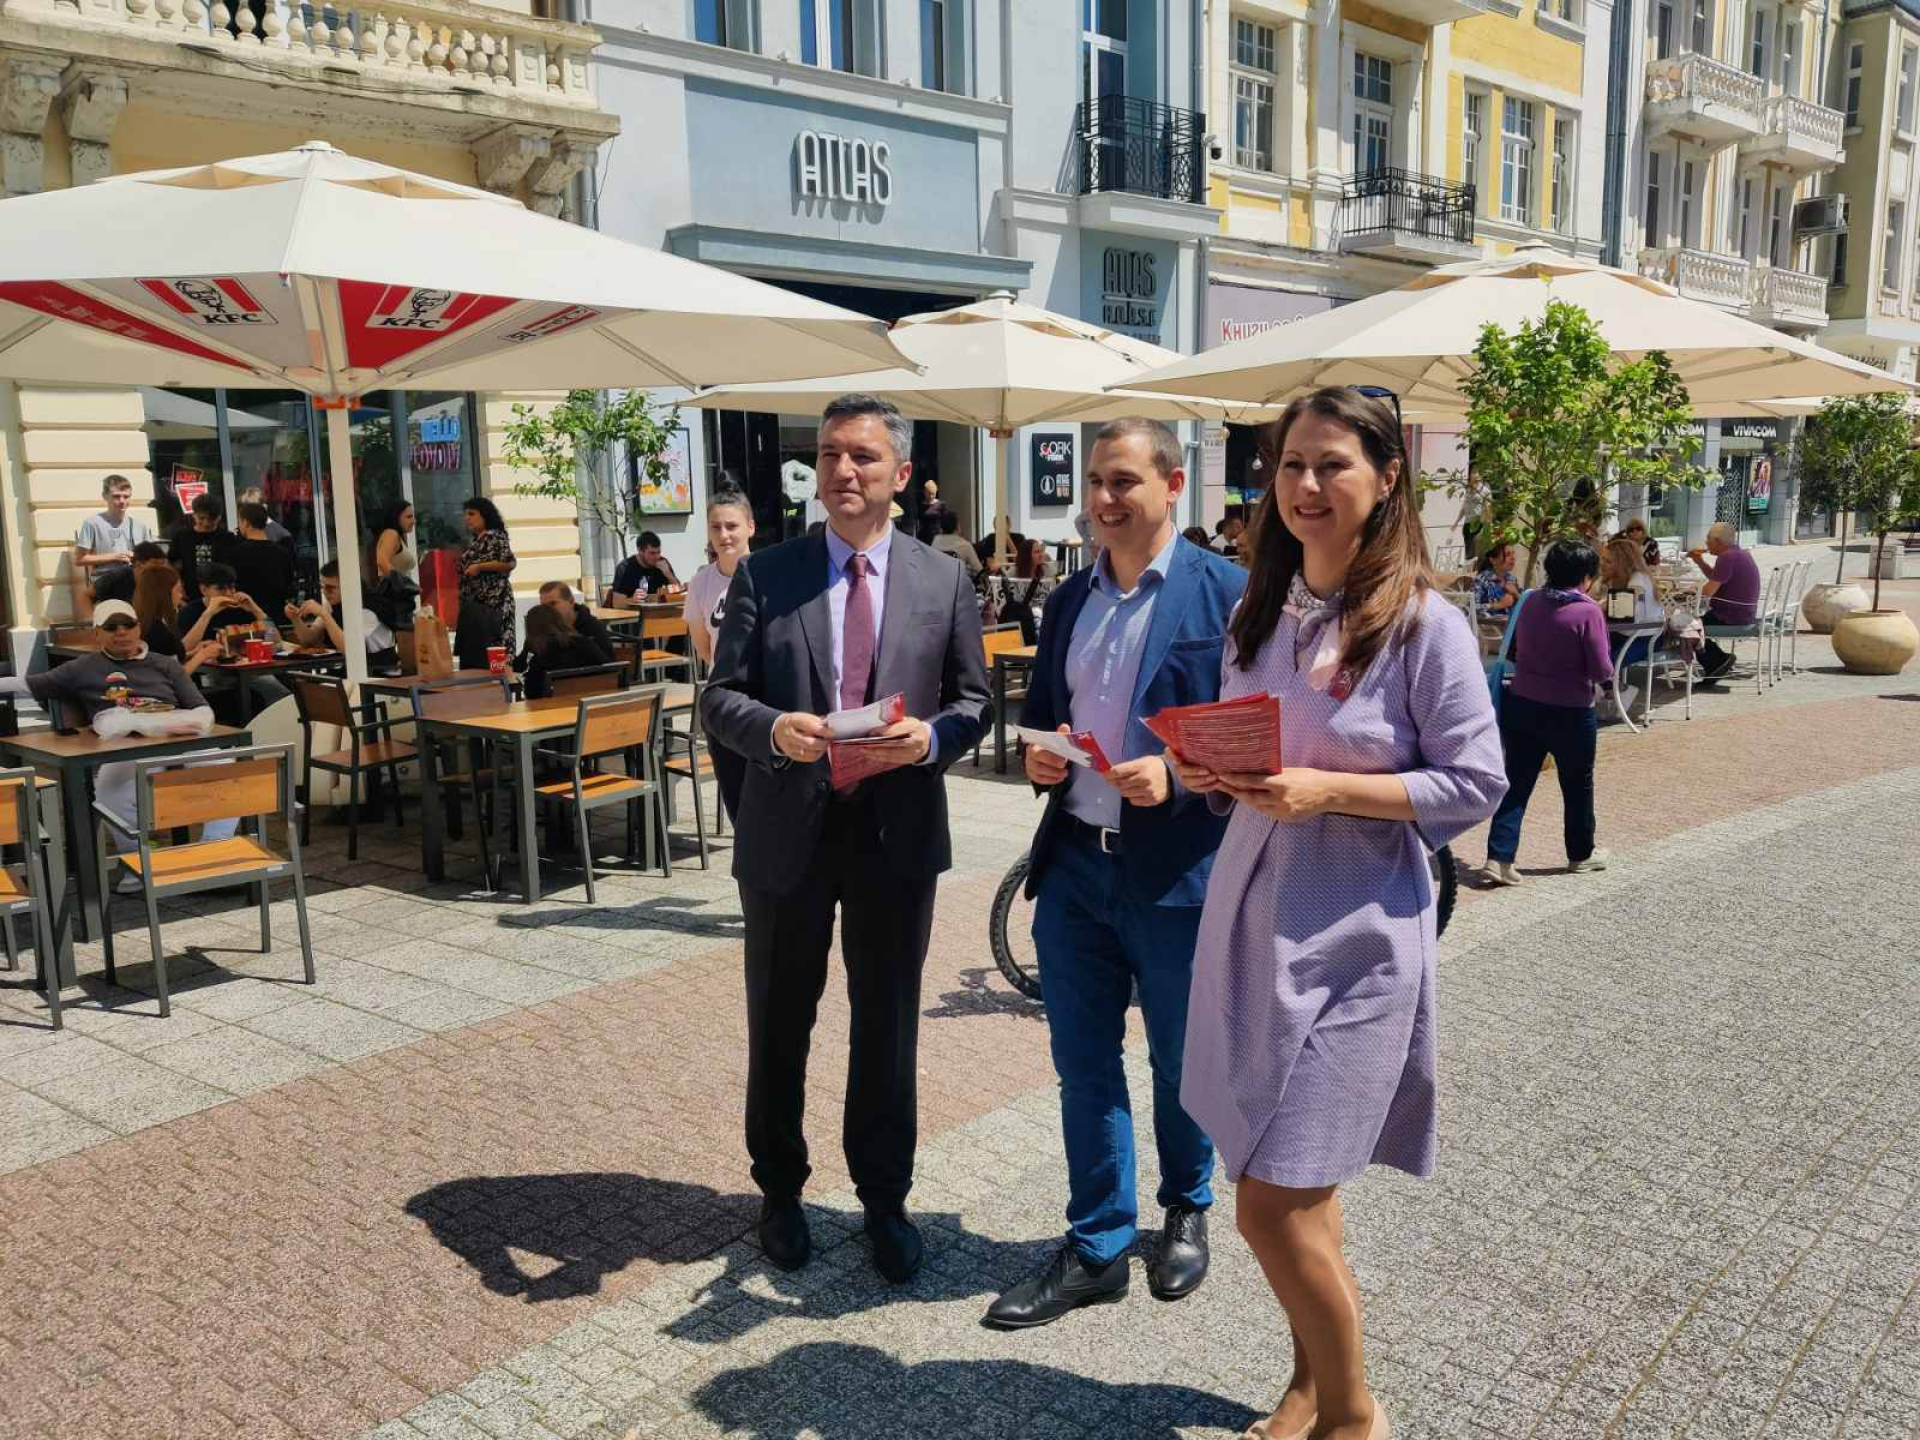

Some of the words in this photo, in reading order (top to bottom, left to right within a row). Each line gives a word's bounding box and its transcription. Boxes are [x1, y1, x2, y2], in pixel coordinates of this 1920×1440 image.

[800, 130, 892, 205] ATLAS
[1103, 247, 1156, 297] ATLAS
[202, 313, 262, 324] KFC
[380, 317, 441, 328] KFC
[1733, 424, 1777, 438] VIVACOM
